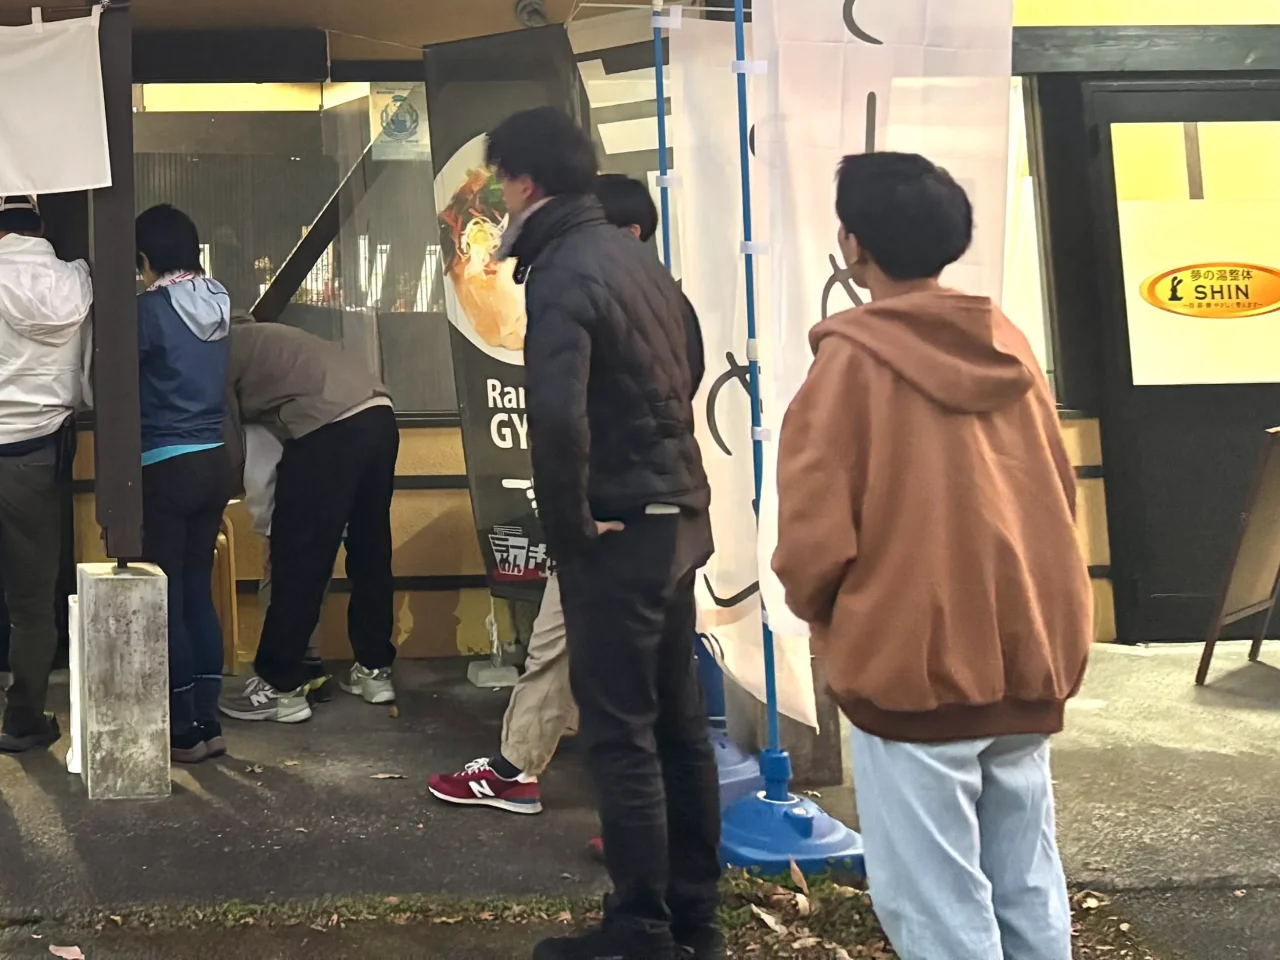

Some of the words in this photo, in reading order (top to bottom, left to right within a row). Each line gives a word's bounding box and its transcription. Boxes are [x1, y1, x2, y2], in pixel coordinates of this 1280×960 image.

[1190, 268, 1254, 282] 夢の湯整体
[1194, 284, 1250, 300] SHIN
